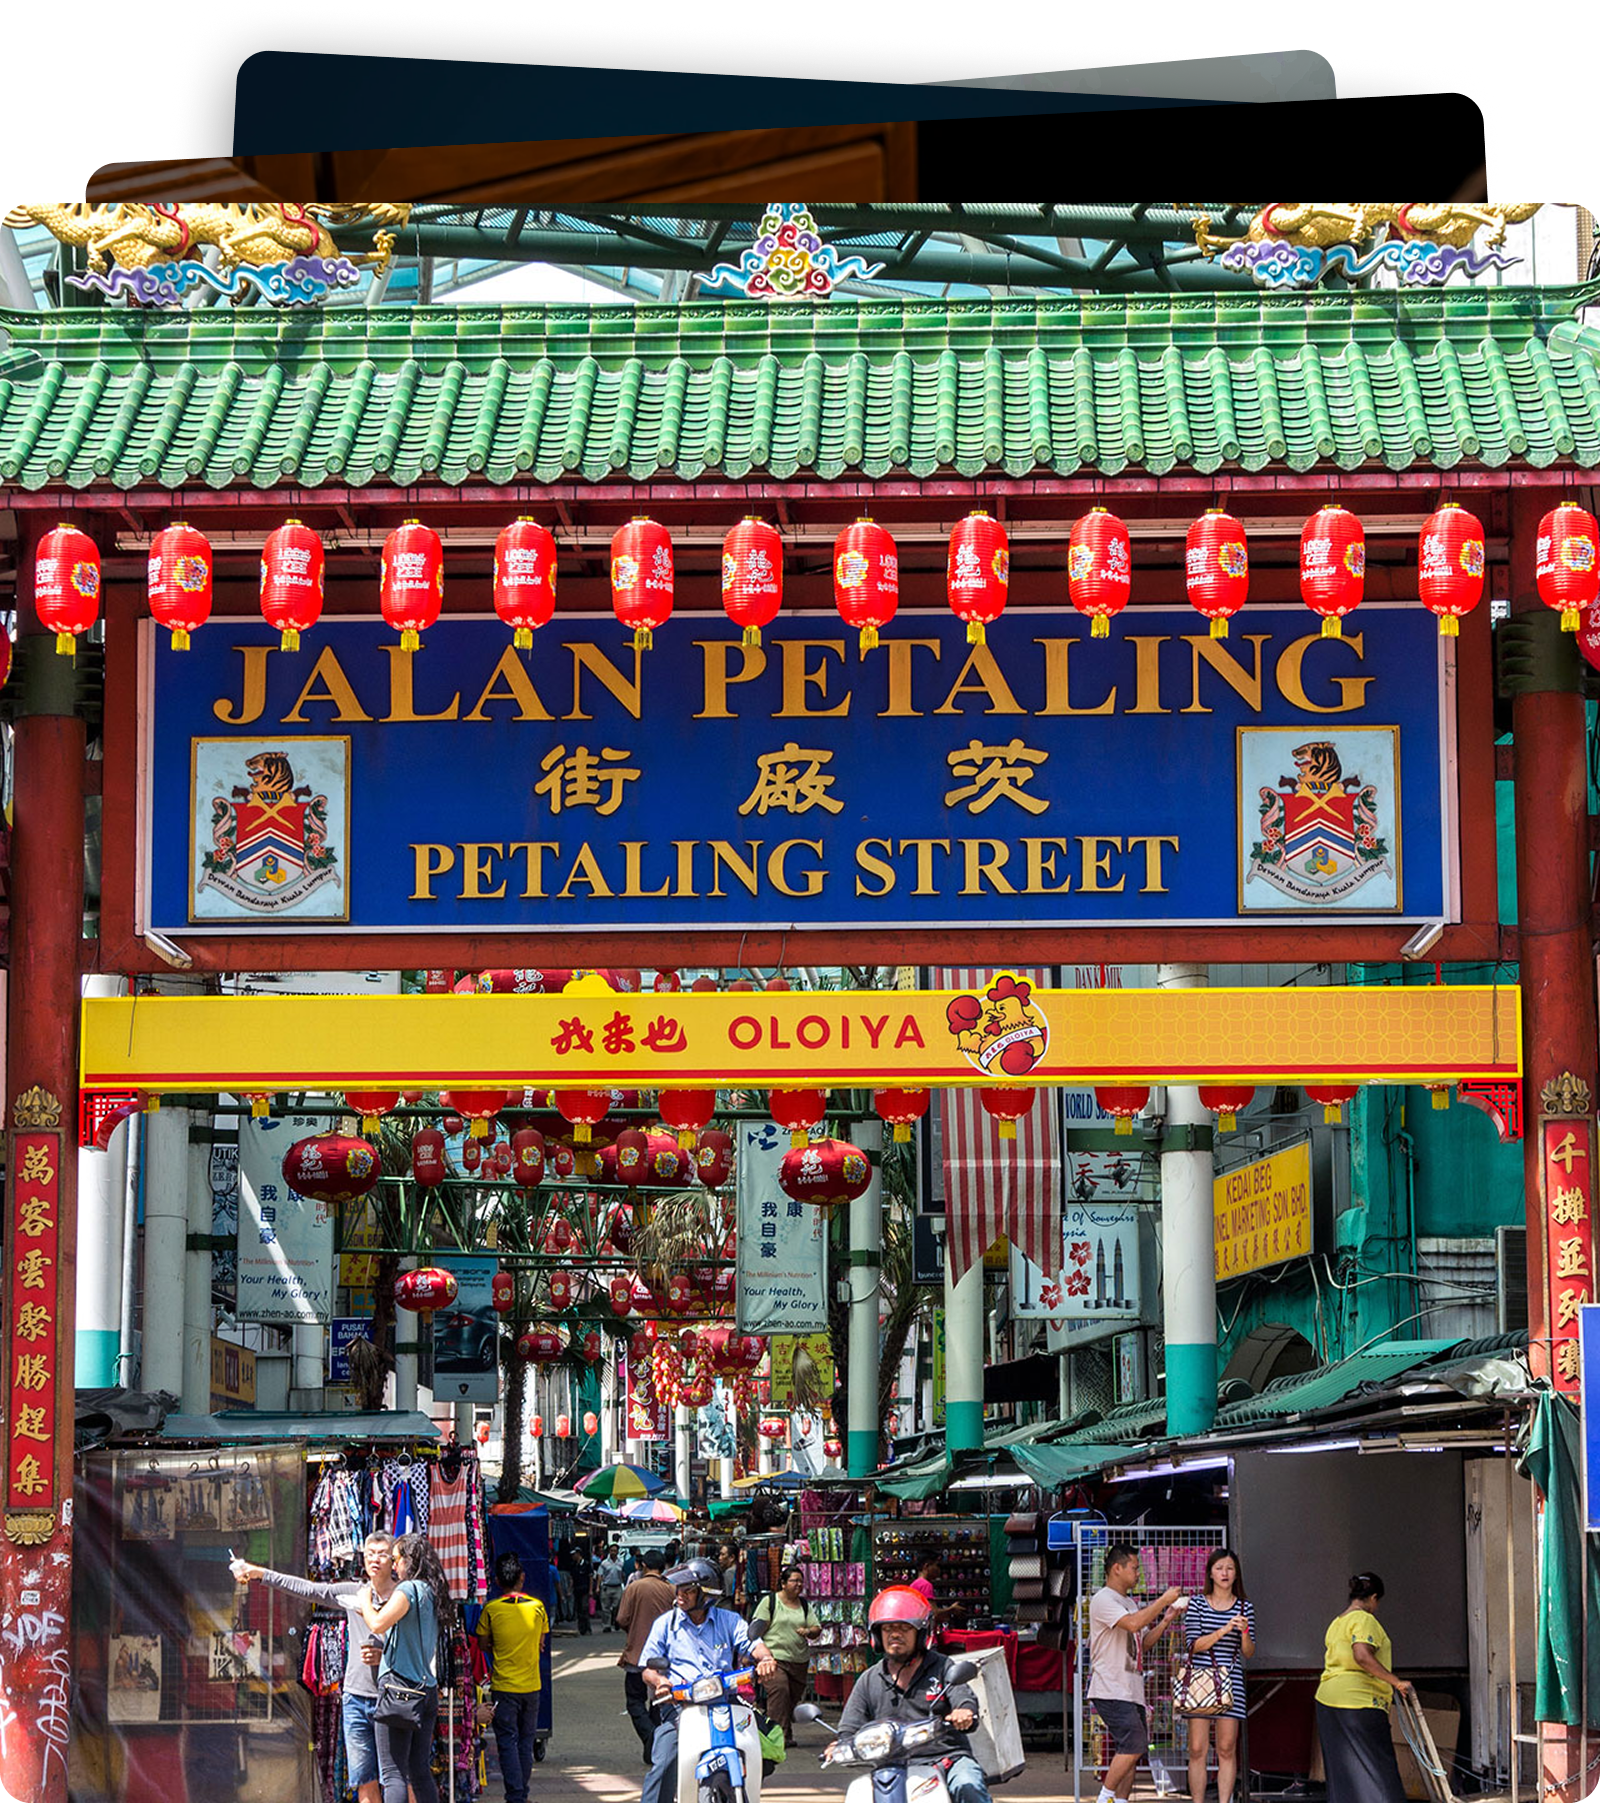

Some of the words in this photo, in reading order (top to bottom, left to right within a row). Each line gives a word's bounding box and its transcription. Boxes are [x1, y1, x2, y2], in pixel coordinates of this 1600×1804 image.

[212, 641, 644, 725] JALAN
[692, 631, 1377, 717] PETALING
[408, 838, 828, 901] PETALING
[854, 835, 1181, 900] STREET
[728, 1014, 926, 1050] OLOIYA
[1004, 1028, 1035, 1044] OLOIYA
[212, 1149, 239, 1160] UTIK
[1226, 1169, 1251, 1206] KEDAI
[1253, 1162, 1273, 1196] BEG
[1214, 1211, 1231, 1244] NEL
[1231, 1196, 1271, 1240] MARKETING
[240, 1275, 264, 1285] Your
[267, 1275, 307, 1287] Health,
[271, 1289, 288, 1300] My
[290, 1288, 321, 1301] Glory
[743, 1286, 766, 1296] Your
[768, 1286, 806, 1298] Health,
[773, 1300, 788, 1311] My
[791, 1300, 818, 1312] Glory
[239, 1309, 330, 1321] www.zhen-ao.com.my
